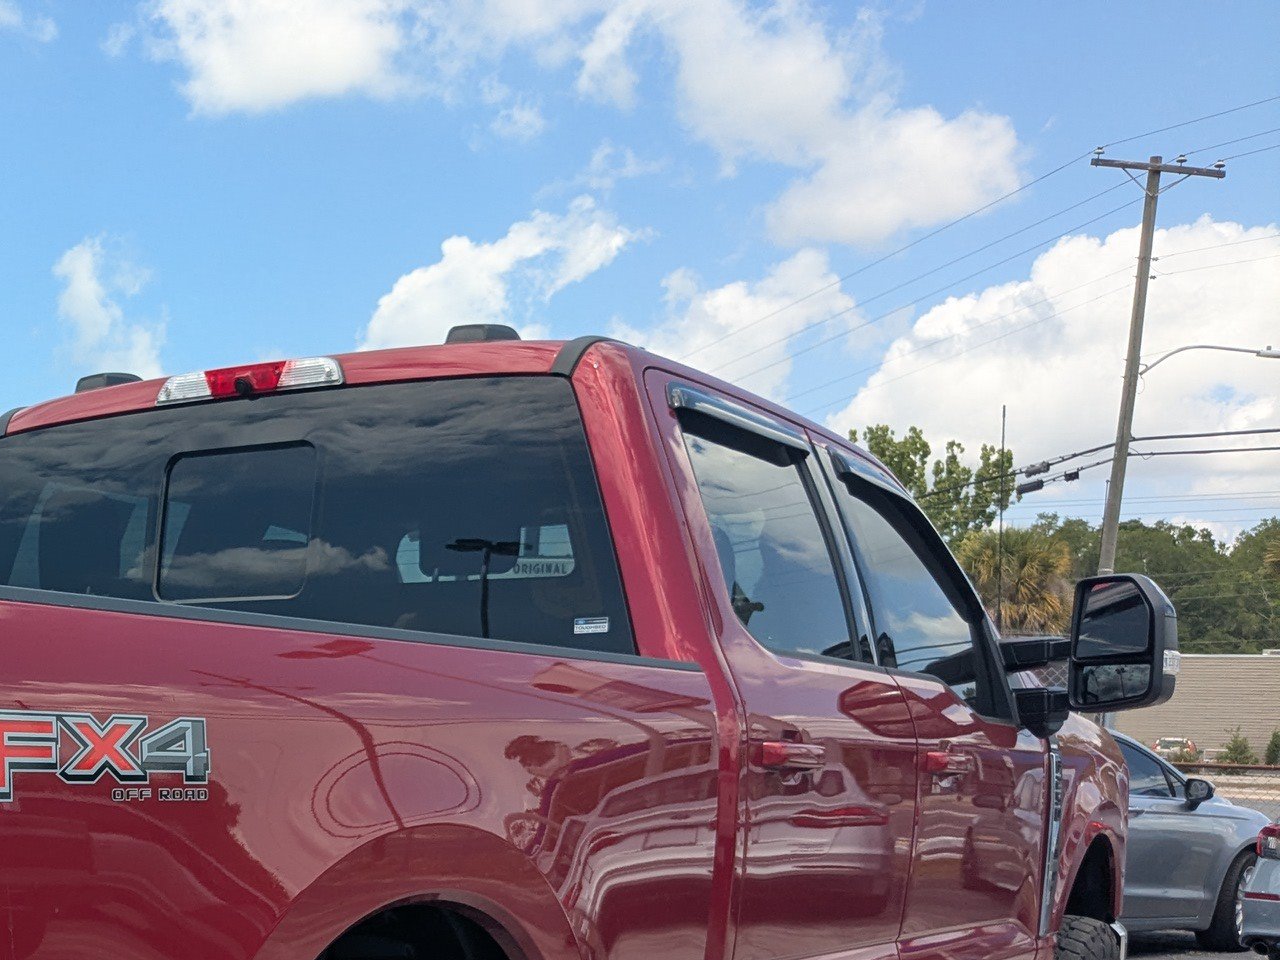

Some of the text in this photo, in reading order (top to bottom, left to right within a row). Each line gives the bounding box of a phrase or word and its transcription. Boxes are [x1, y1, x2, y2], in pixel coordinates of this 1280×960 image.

[514, 562, 567, 575] ORIGINAL
[112, 788, 209, 802] OFF ROAD
